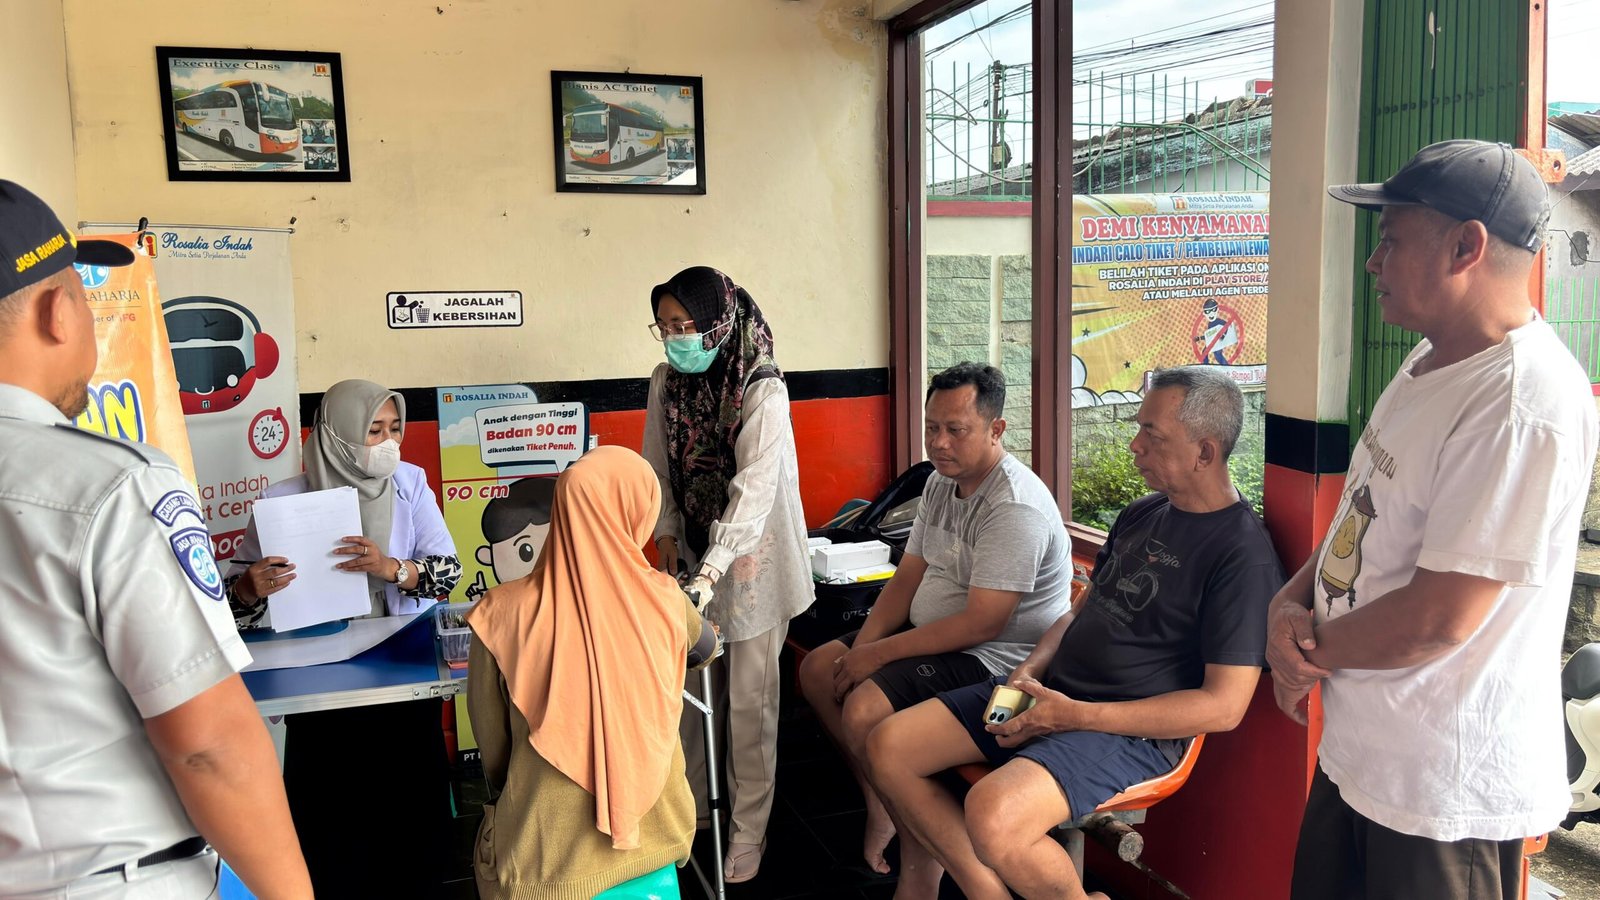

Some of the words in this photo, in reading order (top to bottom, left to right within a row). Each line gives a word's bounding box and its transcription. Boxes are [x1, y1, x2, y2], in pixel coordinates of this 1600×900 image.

[174, 59, 240, 69] Executive
[244, 61, 281, 70] Class
[624, 84, 657, 93] Toilet
[1081, 216, 1138, 239] DEMI
[161, 232, 209, 249] Rosalia
[213, 235, 253, 250] Indah
[202, 251, 230, 260] Perjalanan
[1072, 246, 1113, 263] INDARI
[1115, 244, 1143, 261] CALO
[1145, 243, 1175, 260] TIKET
[1178, 242, 1183, 259] /
[1185, 241, 1242, 258] PEMBELIAN
[16, 250, 40, 272] JASA
[1099, 268, 1145, 279] BELILAH
[1148, 266, 1178, 276] TIKET
[1181, 264, 1211, 275] PADA
[1211, 263, 1256, 273] APLIKASI
[1109, 280, 1155, 290] ROSALIA
[1158, 278, 1190, 288] INDAH
[1192, 276, 1203, 286] DI
[1204, 276, 1229, 284] PLAY
[1143, 291, 1169, 300] ATAU
[1172, 289, 1212, 298] MELALUI
[1215, 287, 1240, 296] AGEN
[444, 298, 503, 306] JAGALAH
[433, 312, 516, 321] KEBERSIHAN
[498, 392, 528, 400] INDAH
[483, 416, 508, 425] Anak
[510, 412, 546, 422] dengan
[548, 408, 578, 418] Tinggi
[261, 426, 276, 441] 24
[486, 427, 532, 441] Badan
[536, 423, 555, 436] 90
[557, 424, 577, 435] cm
[487, 446, 524, 454] dikenakan
[526, 443, 547, 451] Tiket
[548, 442, 576, 450] Penuh.
[220, 474, 269, 497] Indah
[447, 485, 473, 501] 90
[479, 484, 510, 498] cm
[464, 752, 476, 761] PT
